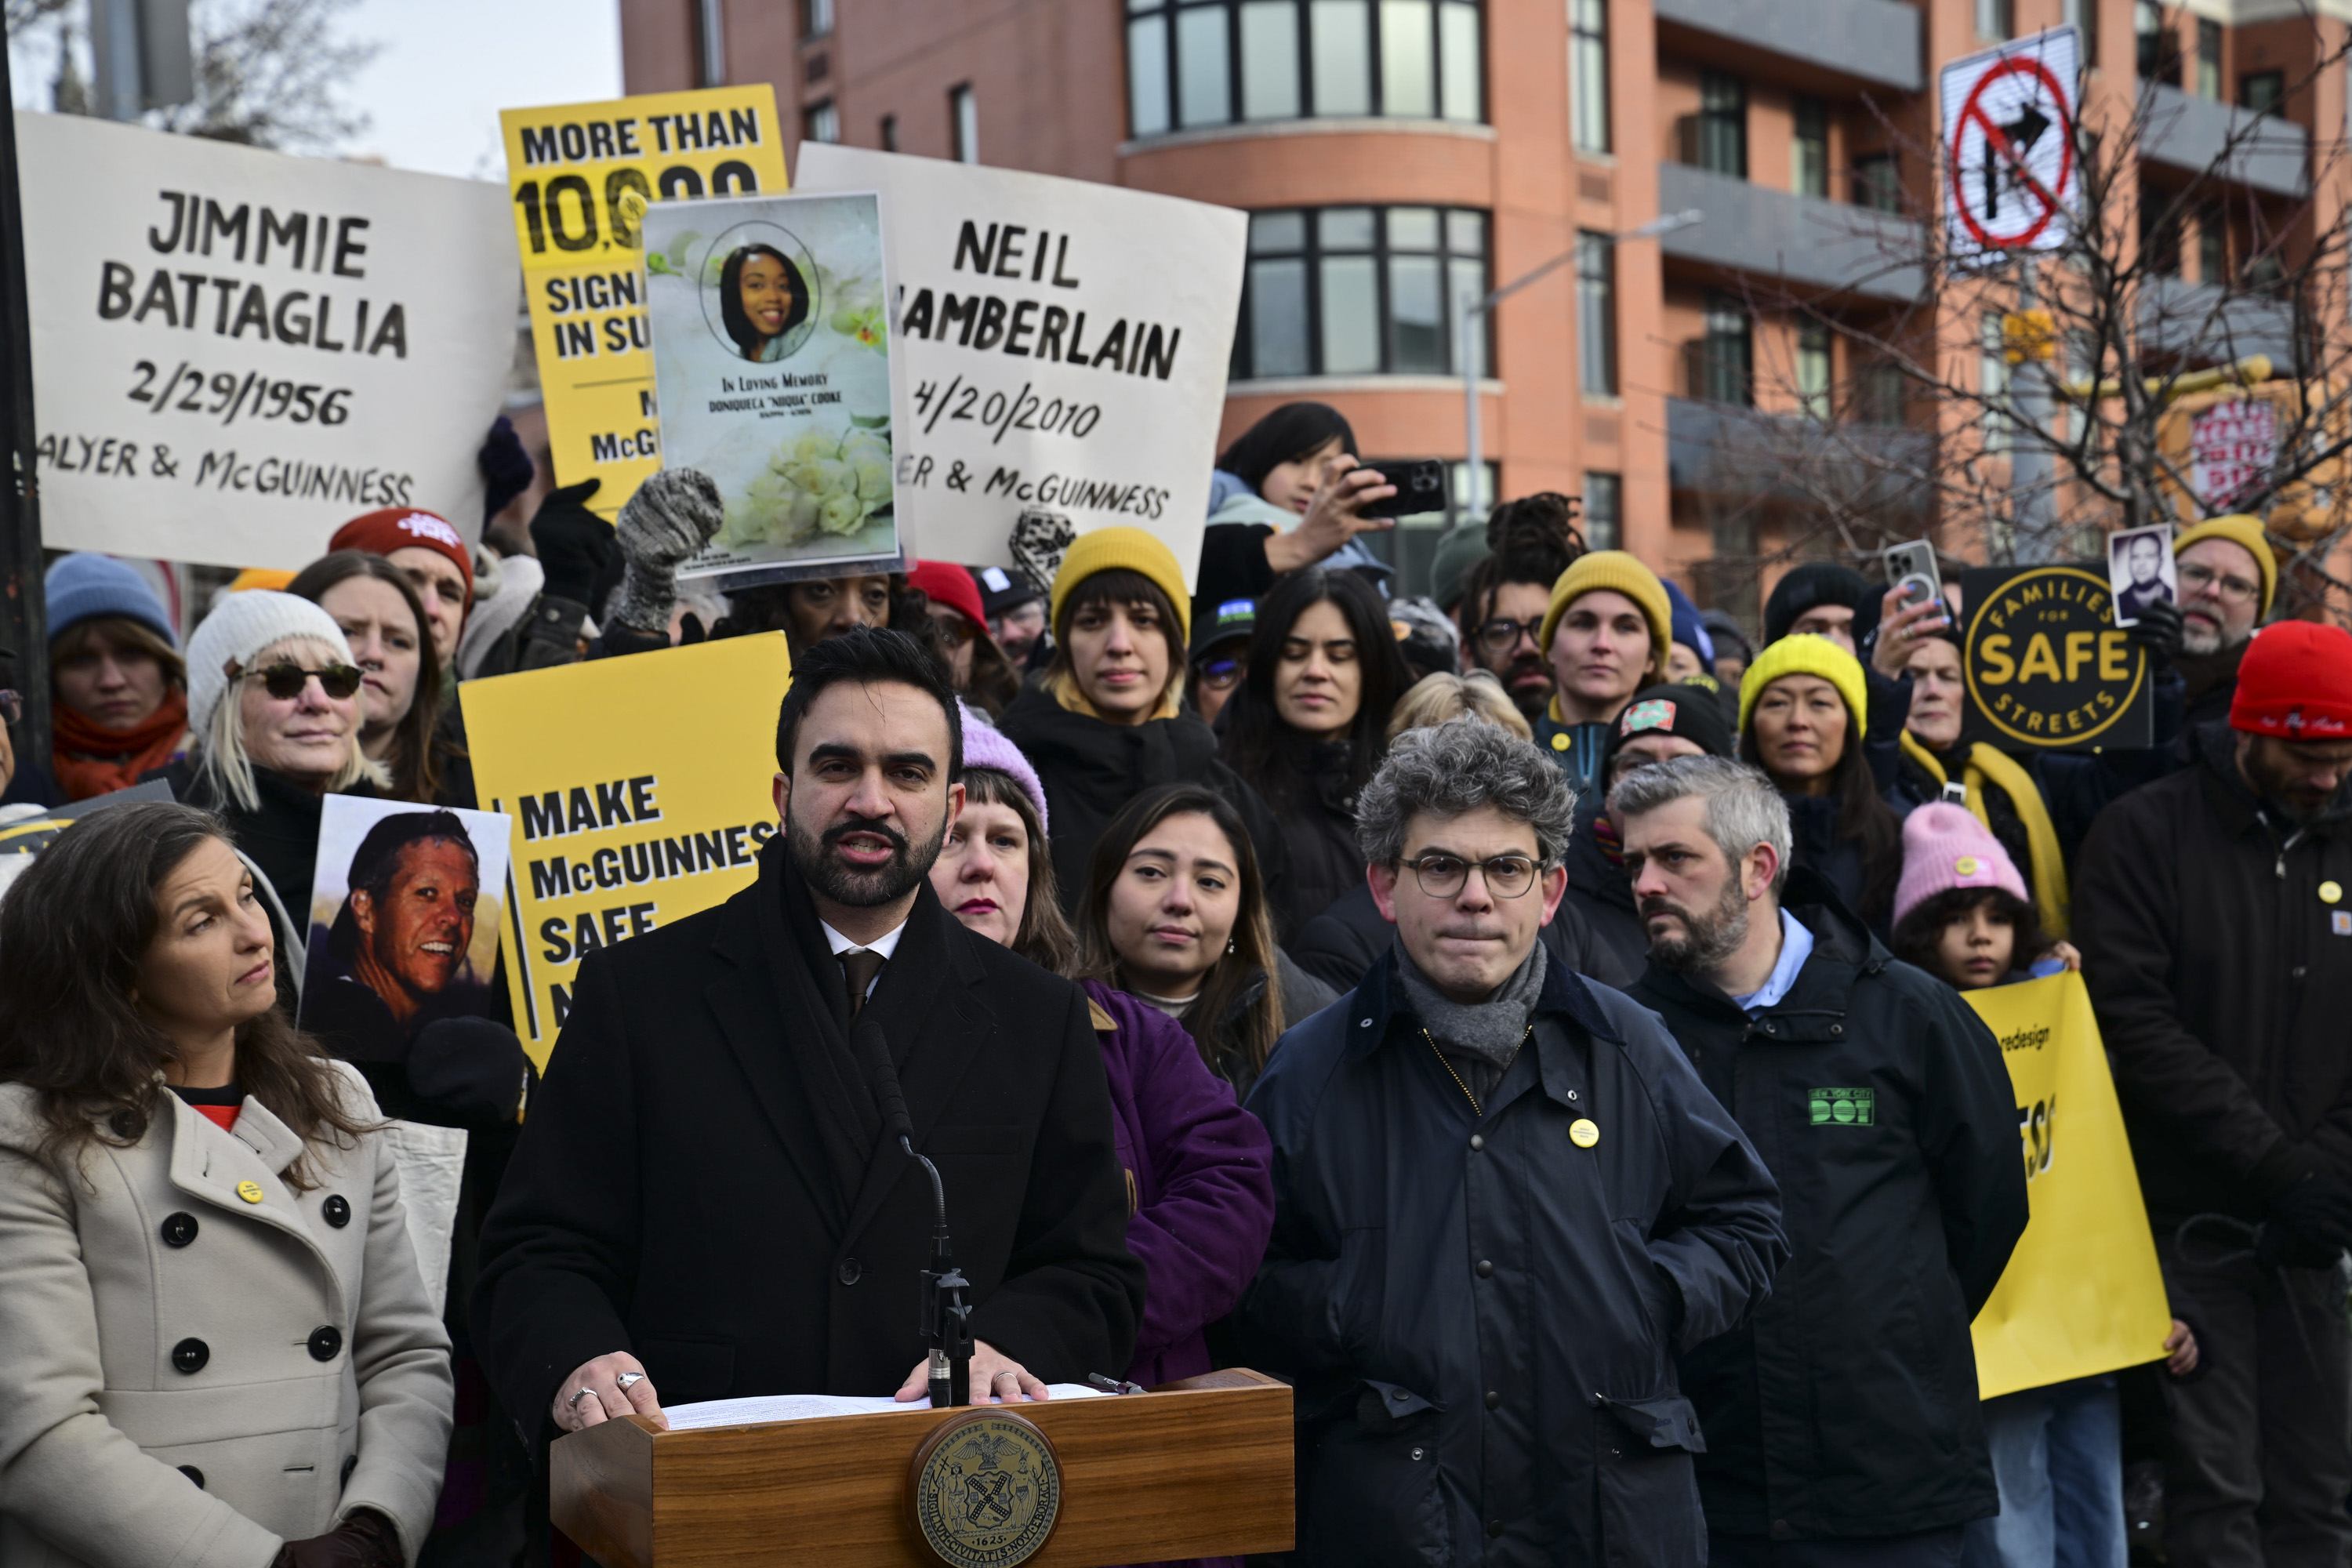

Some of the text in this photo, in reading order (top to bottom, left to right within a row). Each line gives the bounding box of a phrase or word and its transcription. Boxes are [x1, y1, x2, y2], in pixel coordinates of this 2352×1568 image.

[521, 107, 760, 165] MORE THAN
[149, 191, 369, 278] JIMMIE
[953, 220, 1079, 288] NEIL
[98, 261, 406, 359] BATTAGLIA
[546, 271, 648, 315] SIGN
[554, 320, 597, 358] IN
[128, 361, 353, 426] 2/29/1956
[811, 391, 841, 405] COOKE
[914, 374, 1101, 444] 4/20/2010
[591, 429, 661, 462] McG
[151, 443, 179, 477] &
[195, 450, 415, 507] McGUINNESS
[946, 459, 973, 494] &
[984, 466, 1170, 519] McGUINNESS
[1989, 579, 2114, 629] FAMILIES
[2038, 610, 2069, 622] FOR
[1980, 630, 2129, 685] SAFE
[1994, 691, 2114, 733] STREETS
[519, 775, 662, 841] MAKE
[529, 821, 782, 900] McGUINNES
[539, 902, 659, 964] SAFE
[2001, 1024, 2050, 1052] redesign
[1811, 1099, 1871, 1123] DOT
[929, 1482, 1049, 1562] SIGILLUM CIVITATIS NOVI EBORACI
[976, 1535, 1004, 1546] 1625
